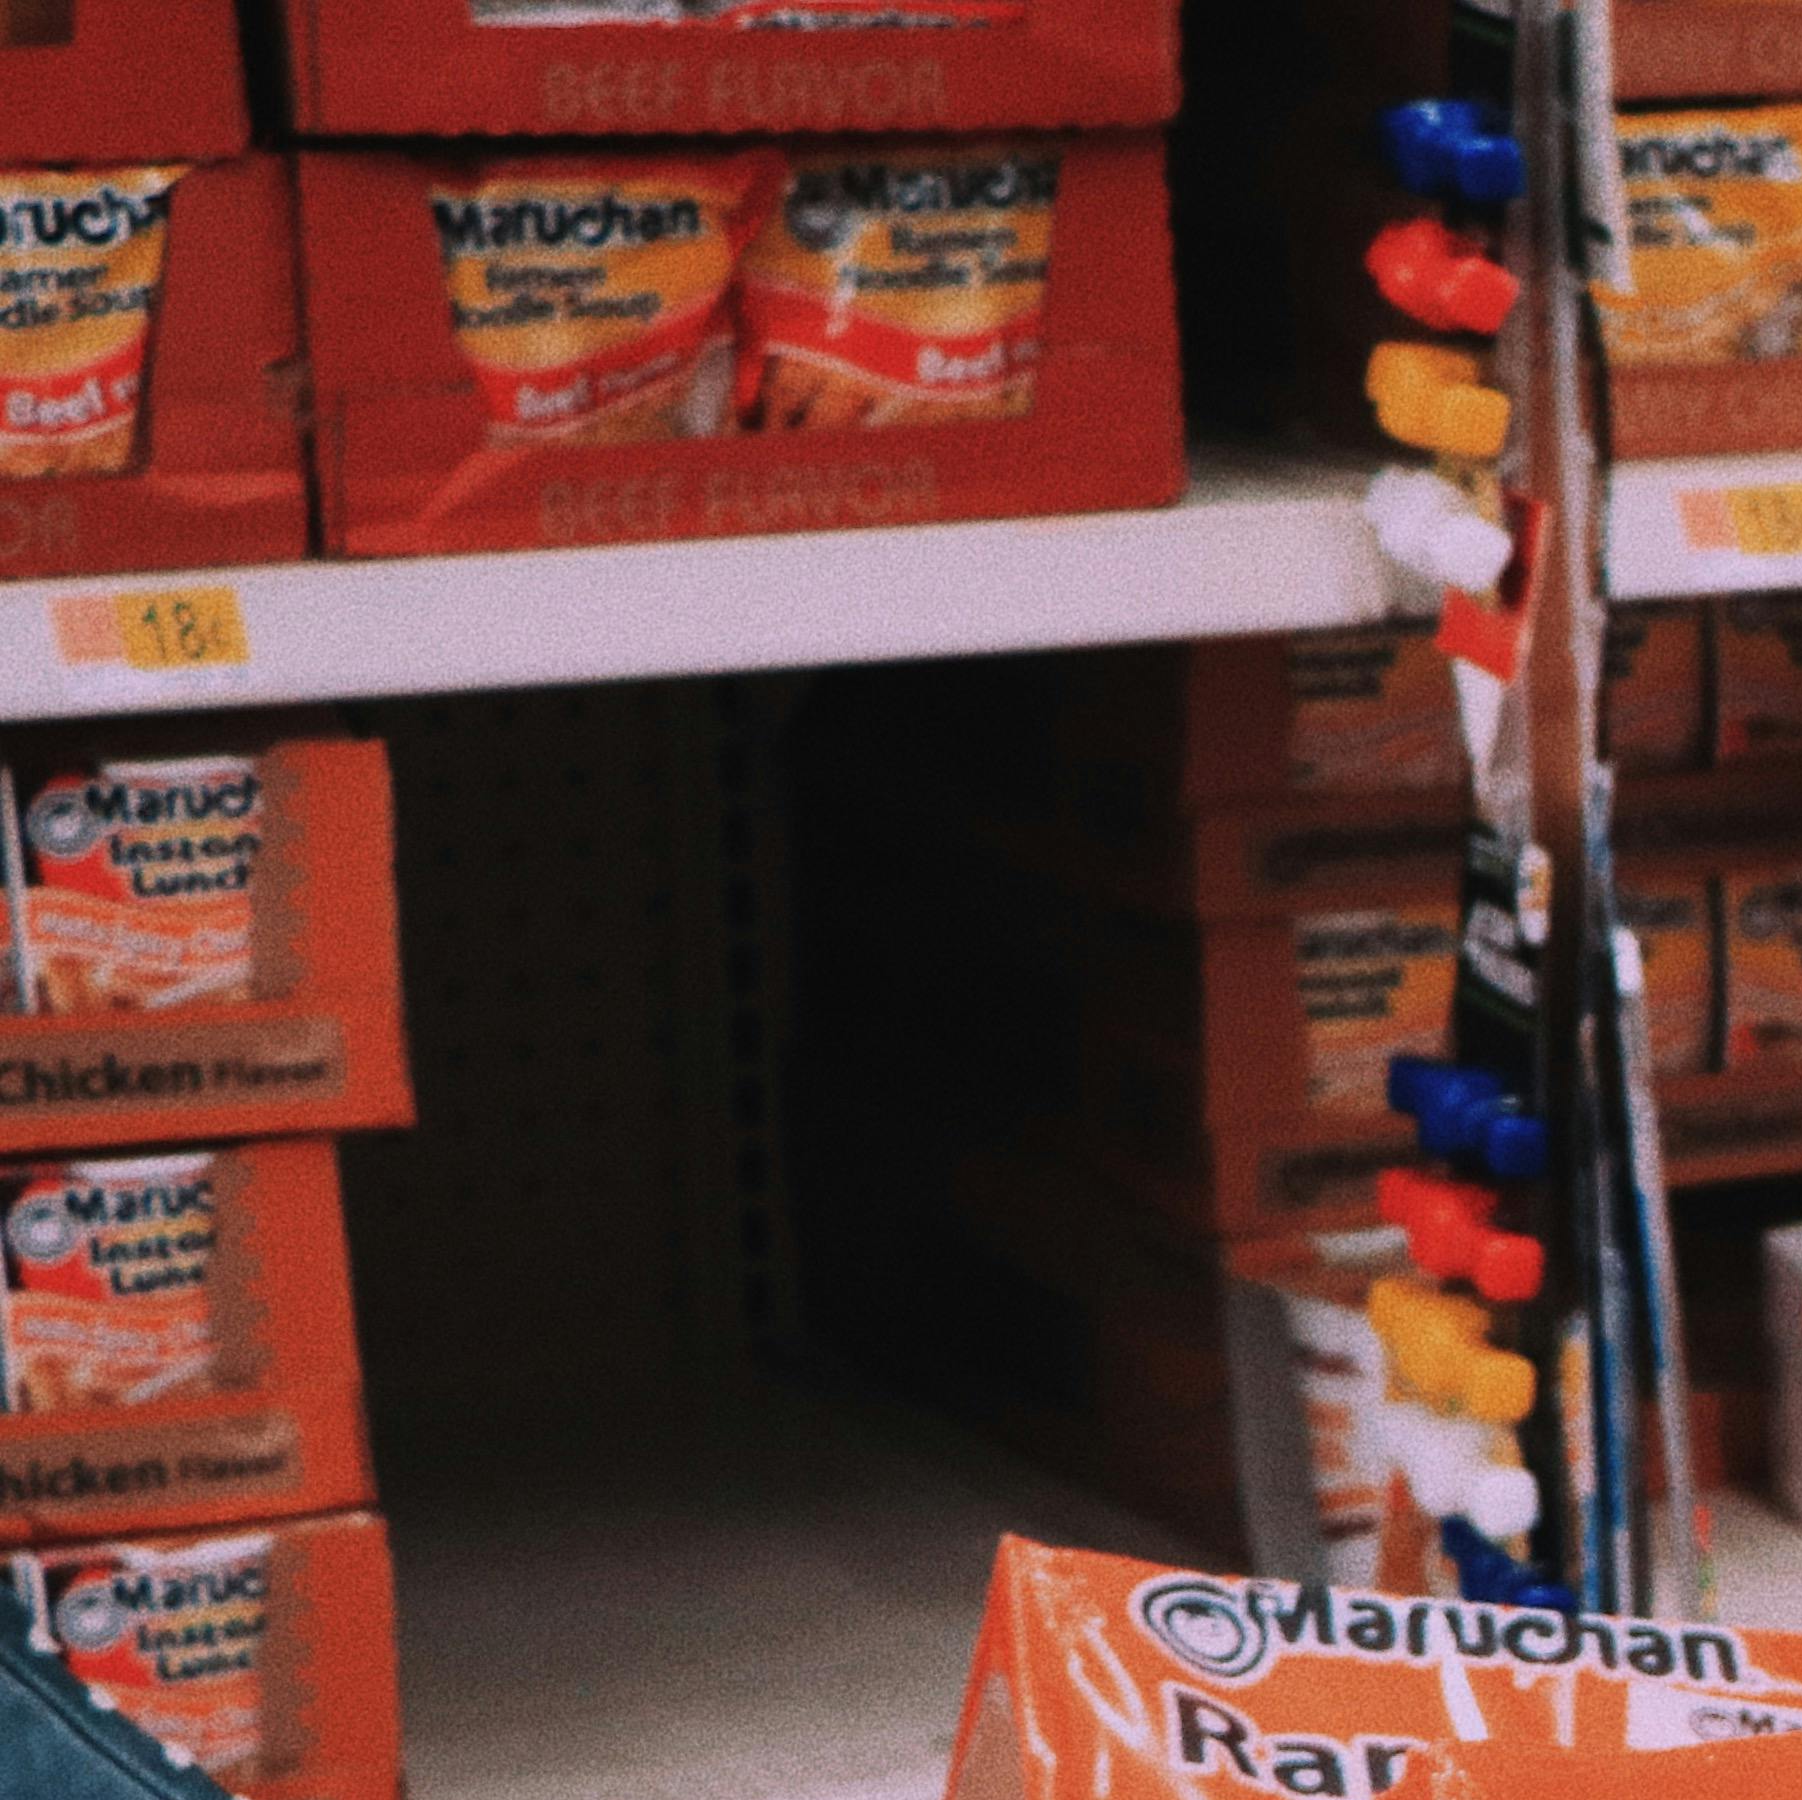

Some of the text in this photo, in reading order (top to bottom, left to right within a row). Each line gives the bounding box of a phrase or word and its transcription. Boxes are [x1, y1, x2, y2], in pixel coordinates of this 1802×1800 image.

[543, 57, 945, 122] BEEF FLAVOR
[432, 196, 700, 248] Maruchan
[6, 377, 107, 427] Beef
[540, 460, 937, 541] BEEF FLAVOR
[0, 1054, 202, 1104] Chicken
[1250, 1584, 1738, 1682] Maruchan
